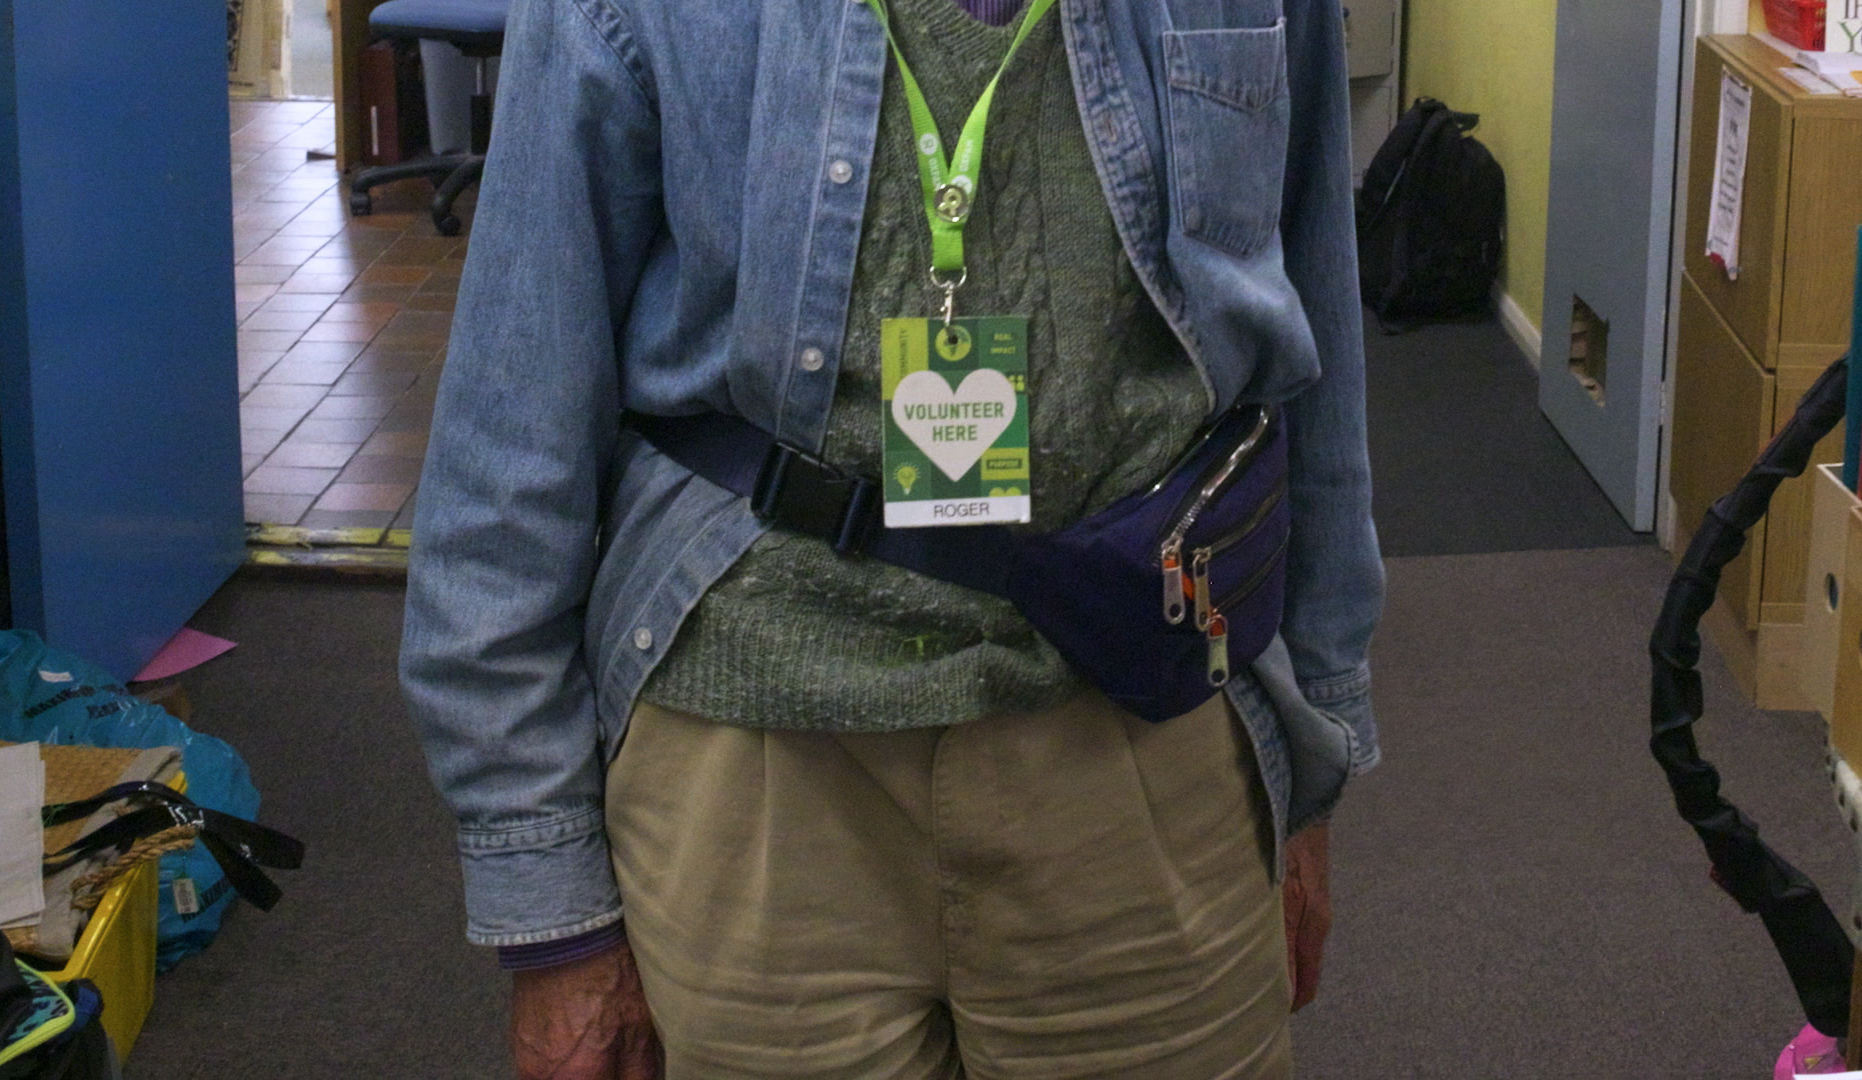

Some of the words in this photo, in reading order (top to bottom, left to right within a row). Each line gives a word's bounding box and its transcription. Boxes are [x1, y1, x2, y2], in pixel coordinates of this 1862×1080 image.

[904, 402, 1004, 420] VOLUNTEER
[932, 424, 978, 442] HERE
[933, 502, 990, 518] ROGER
